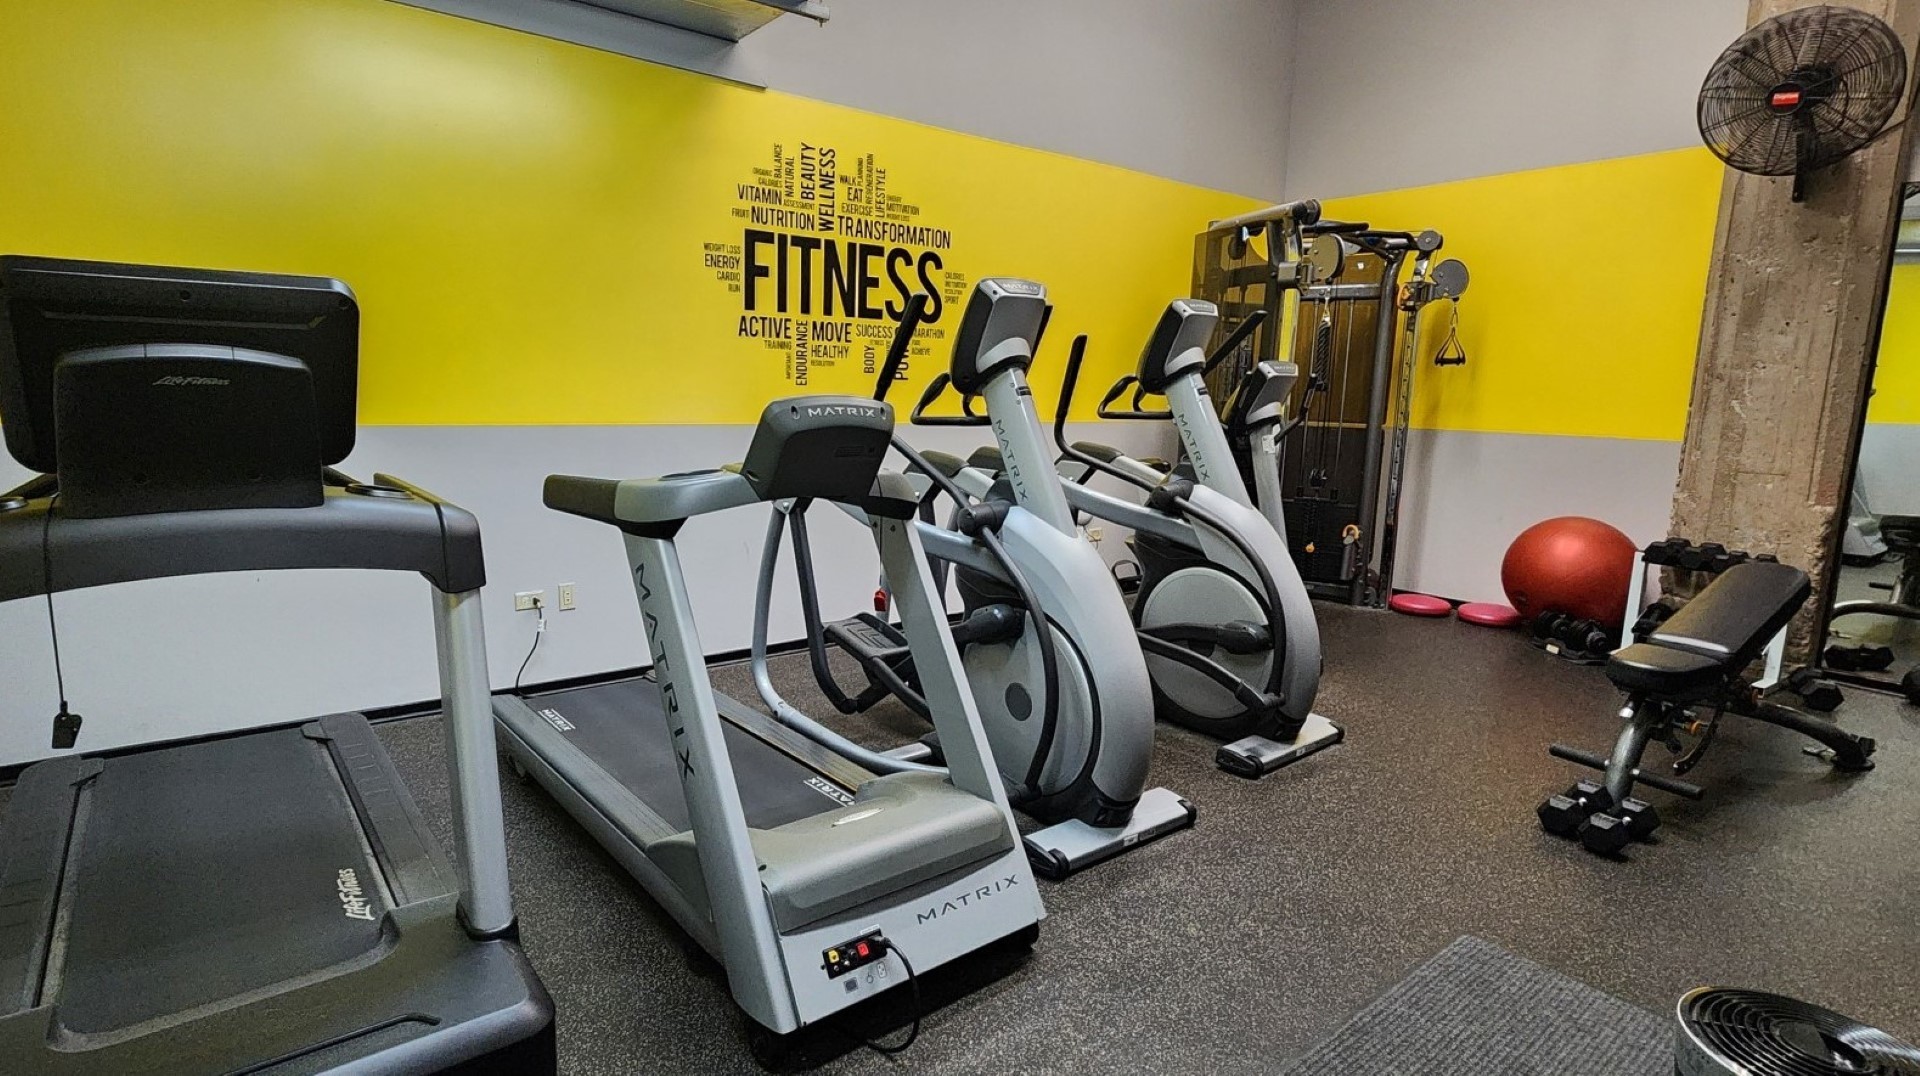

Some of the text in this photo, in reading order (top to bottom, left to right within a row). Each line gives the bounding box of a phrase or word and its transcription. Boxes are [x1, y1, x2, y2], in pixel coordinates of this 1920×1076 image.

[773, 143, 782, 179] BALANCE
[800, 142, 816, 200] BEAUTY
[784, 156, 795, 197] NATURAL
[839, 175, 856, 186] WALK
[737, 183, 782, 206] VITAMIN
[818, 147, 835, 232] WELLNESS
[847, 187, 863, 202] EAT
[875, 168, 886, 218] LIFESTYLE
[731, 207, 749, 219] FRUIT
[751, 206, 815, 232] NUTRITION
[841, 203, 873, 216] EXERCISE
[886, 203, 919, 215] MOTIVATION
[837, 215, 951, 249] TRANSFORMATION
[704, 243, 741, 254] WEIGHT LOSS
[704, 254, 740, 270] ENERGY
[717, 271, 741, 282] CARDIO
[744, 228, 943, 324] FITNESS
[728, 283, 740, 293] RUN
[738, 316, 792, 339] ACTIVE
[811, 321, 852, 343] MOVE
[856, 323, 893, 338] SUCCESS
[764, 340, 792, 350] TRAINING
[796, 320, 808, 386] ENDURANCE
[811, 344, 849, 359] HEALTHY
[863, 345, 875, 374] BODY
[807, 406, 876, 418] MATRIX
[1179, 413, 1211, 481] MATRIX
[995, 419, 1029, 501] MATRIX
[634, 563, 696, 784] MATRIX
[916, 874, 1019, 925] MATRIX
